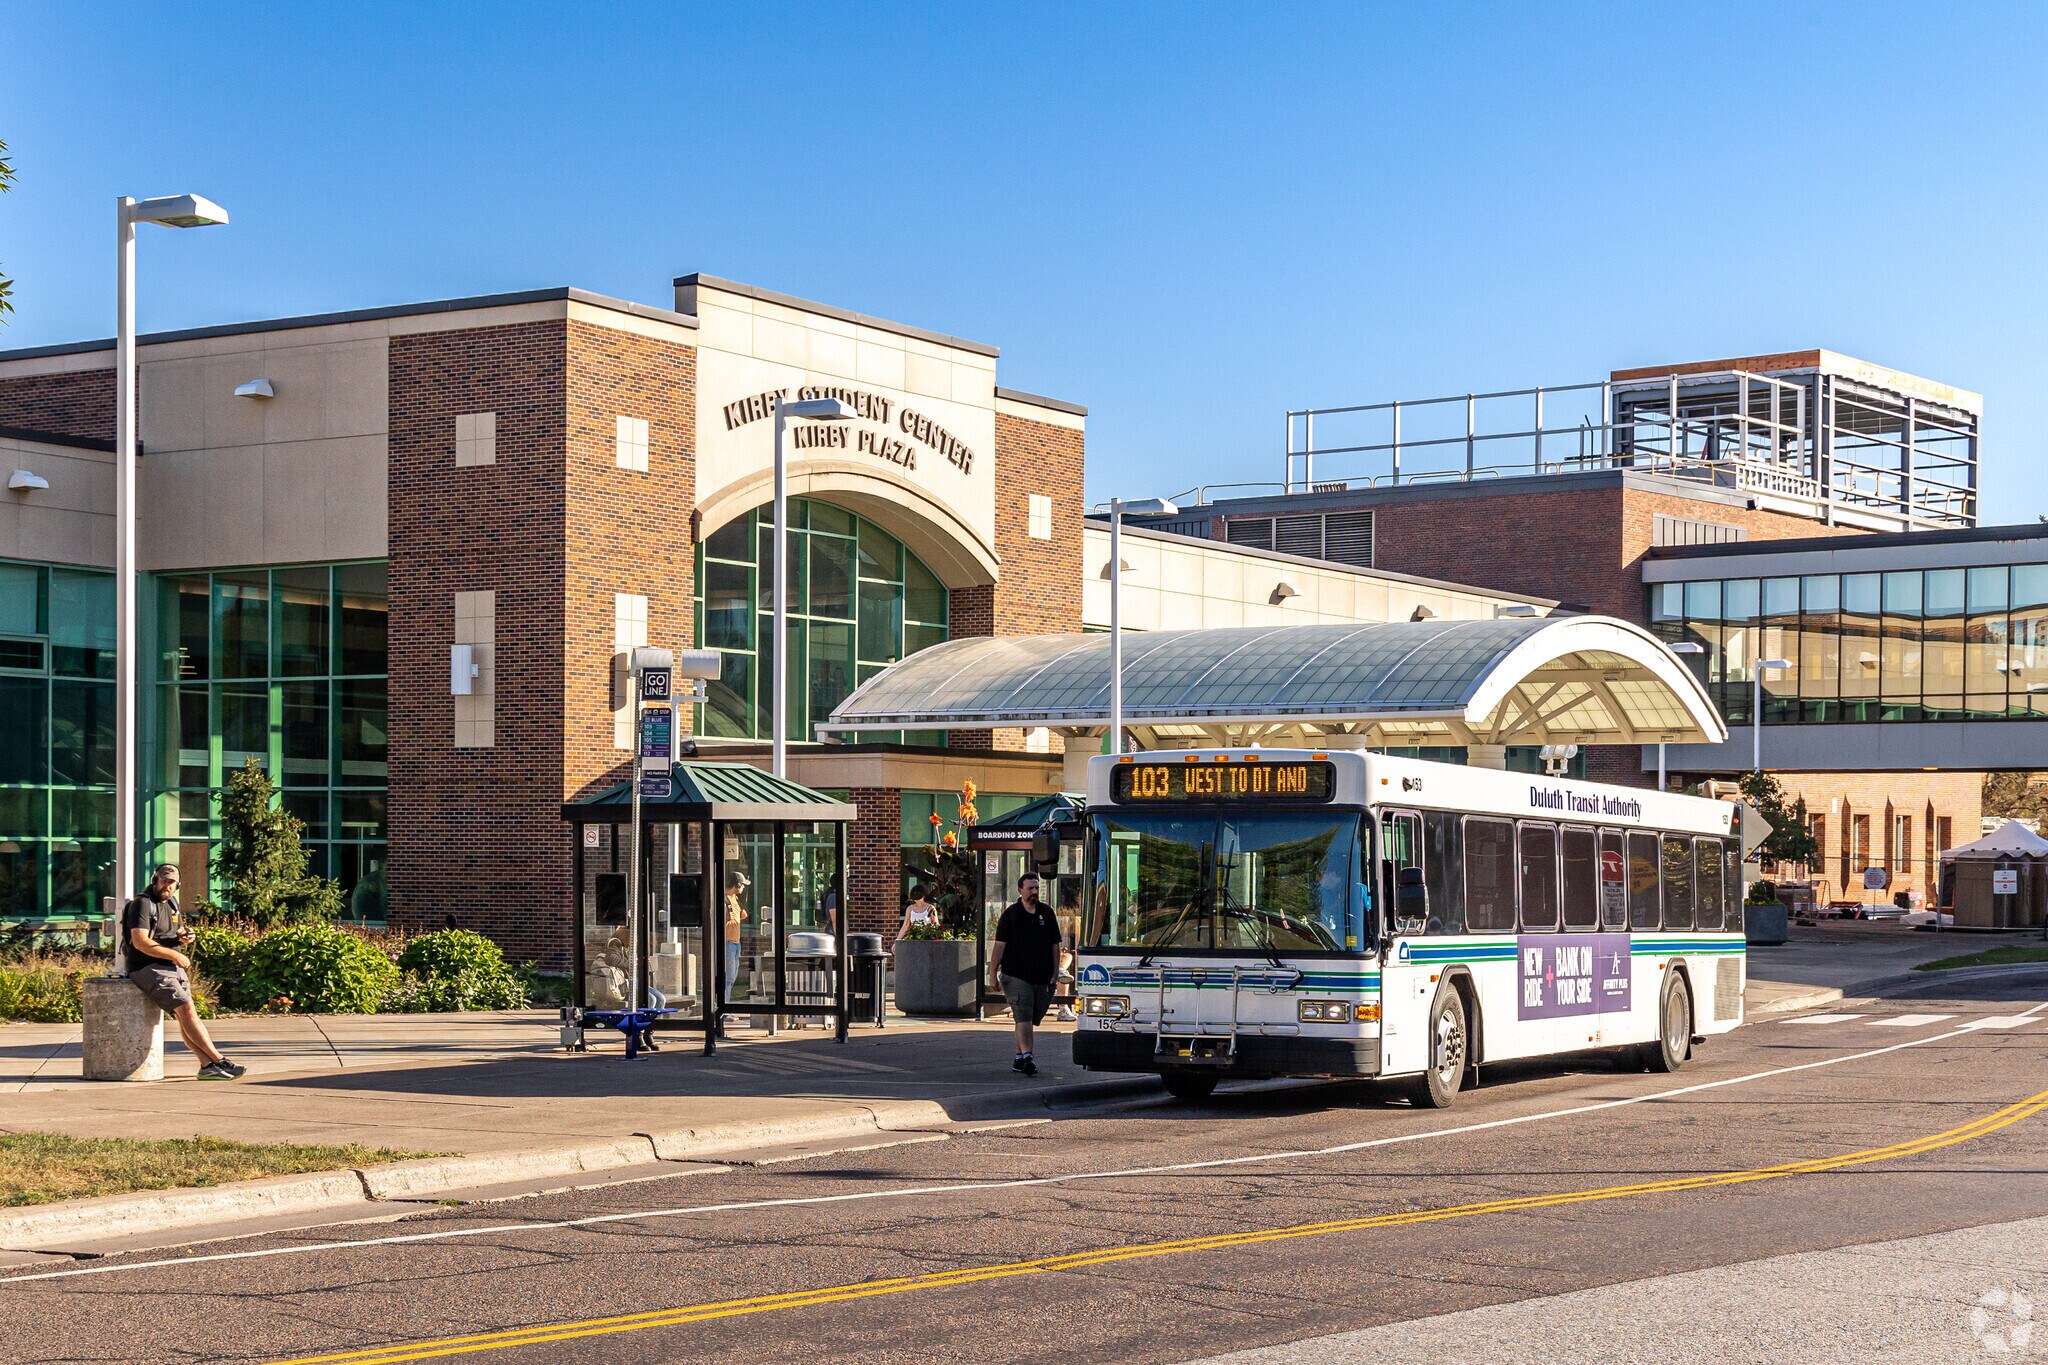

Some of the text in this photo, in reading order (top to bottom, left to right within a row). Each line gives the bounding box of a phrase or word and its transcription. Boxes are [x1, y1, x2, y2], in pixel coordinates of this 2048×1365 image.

[793, 425, 916, 471] KIRBY PLAZA
[900, 408, 975, 475] CENTER
[644, 686, 664, 696] LINE
[648, 675, 666, 687] GO
[1131, 766, 1307, 797] 103 WEST TO DT AND
[1530, 786, 1642, 822] Duluth Transit Authority
[1523, 947, 1543, 976] NEW
[1555, 946, 1593, 977] BANK ON
[1524, 978, 1543, 1007] RIDE
[1556, 977, 1593, 1005] YOUR SIDE
